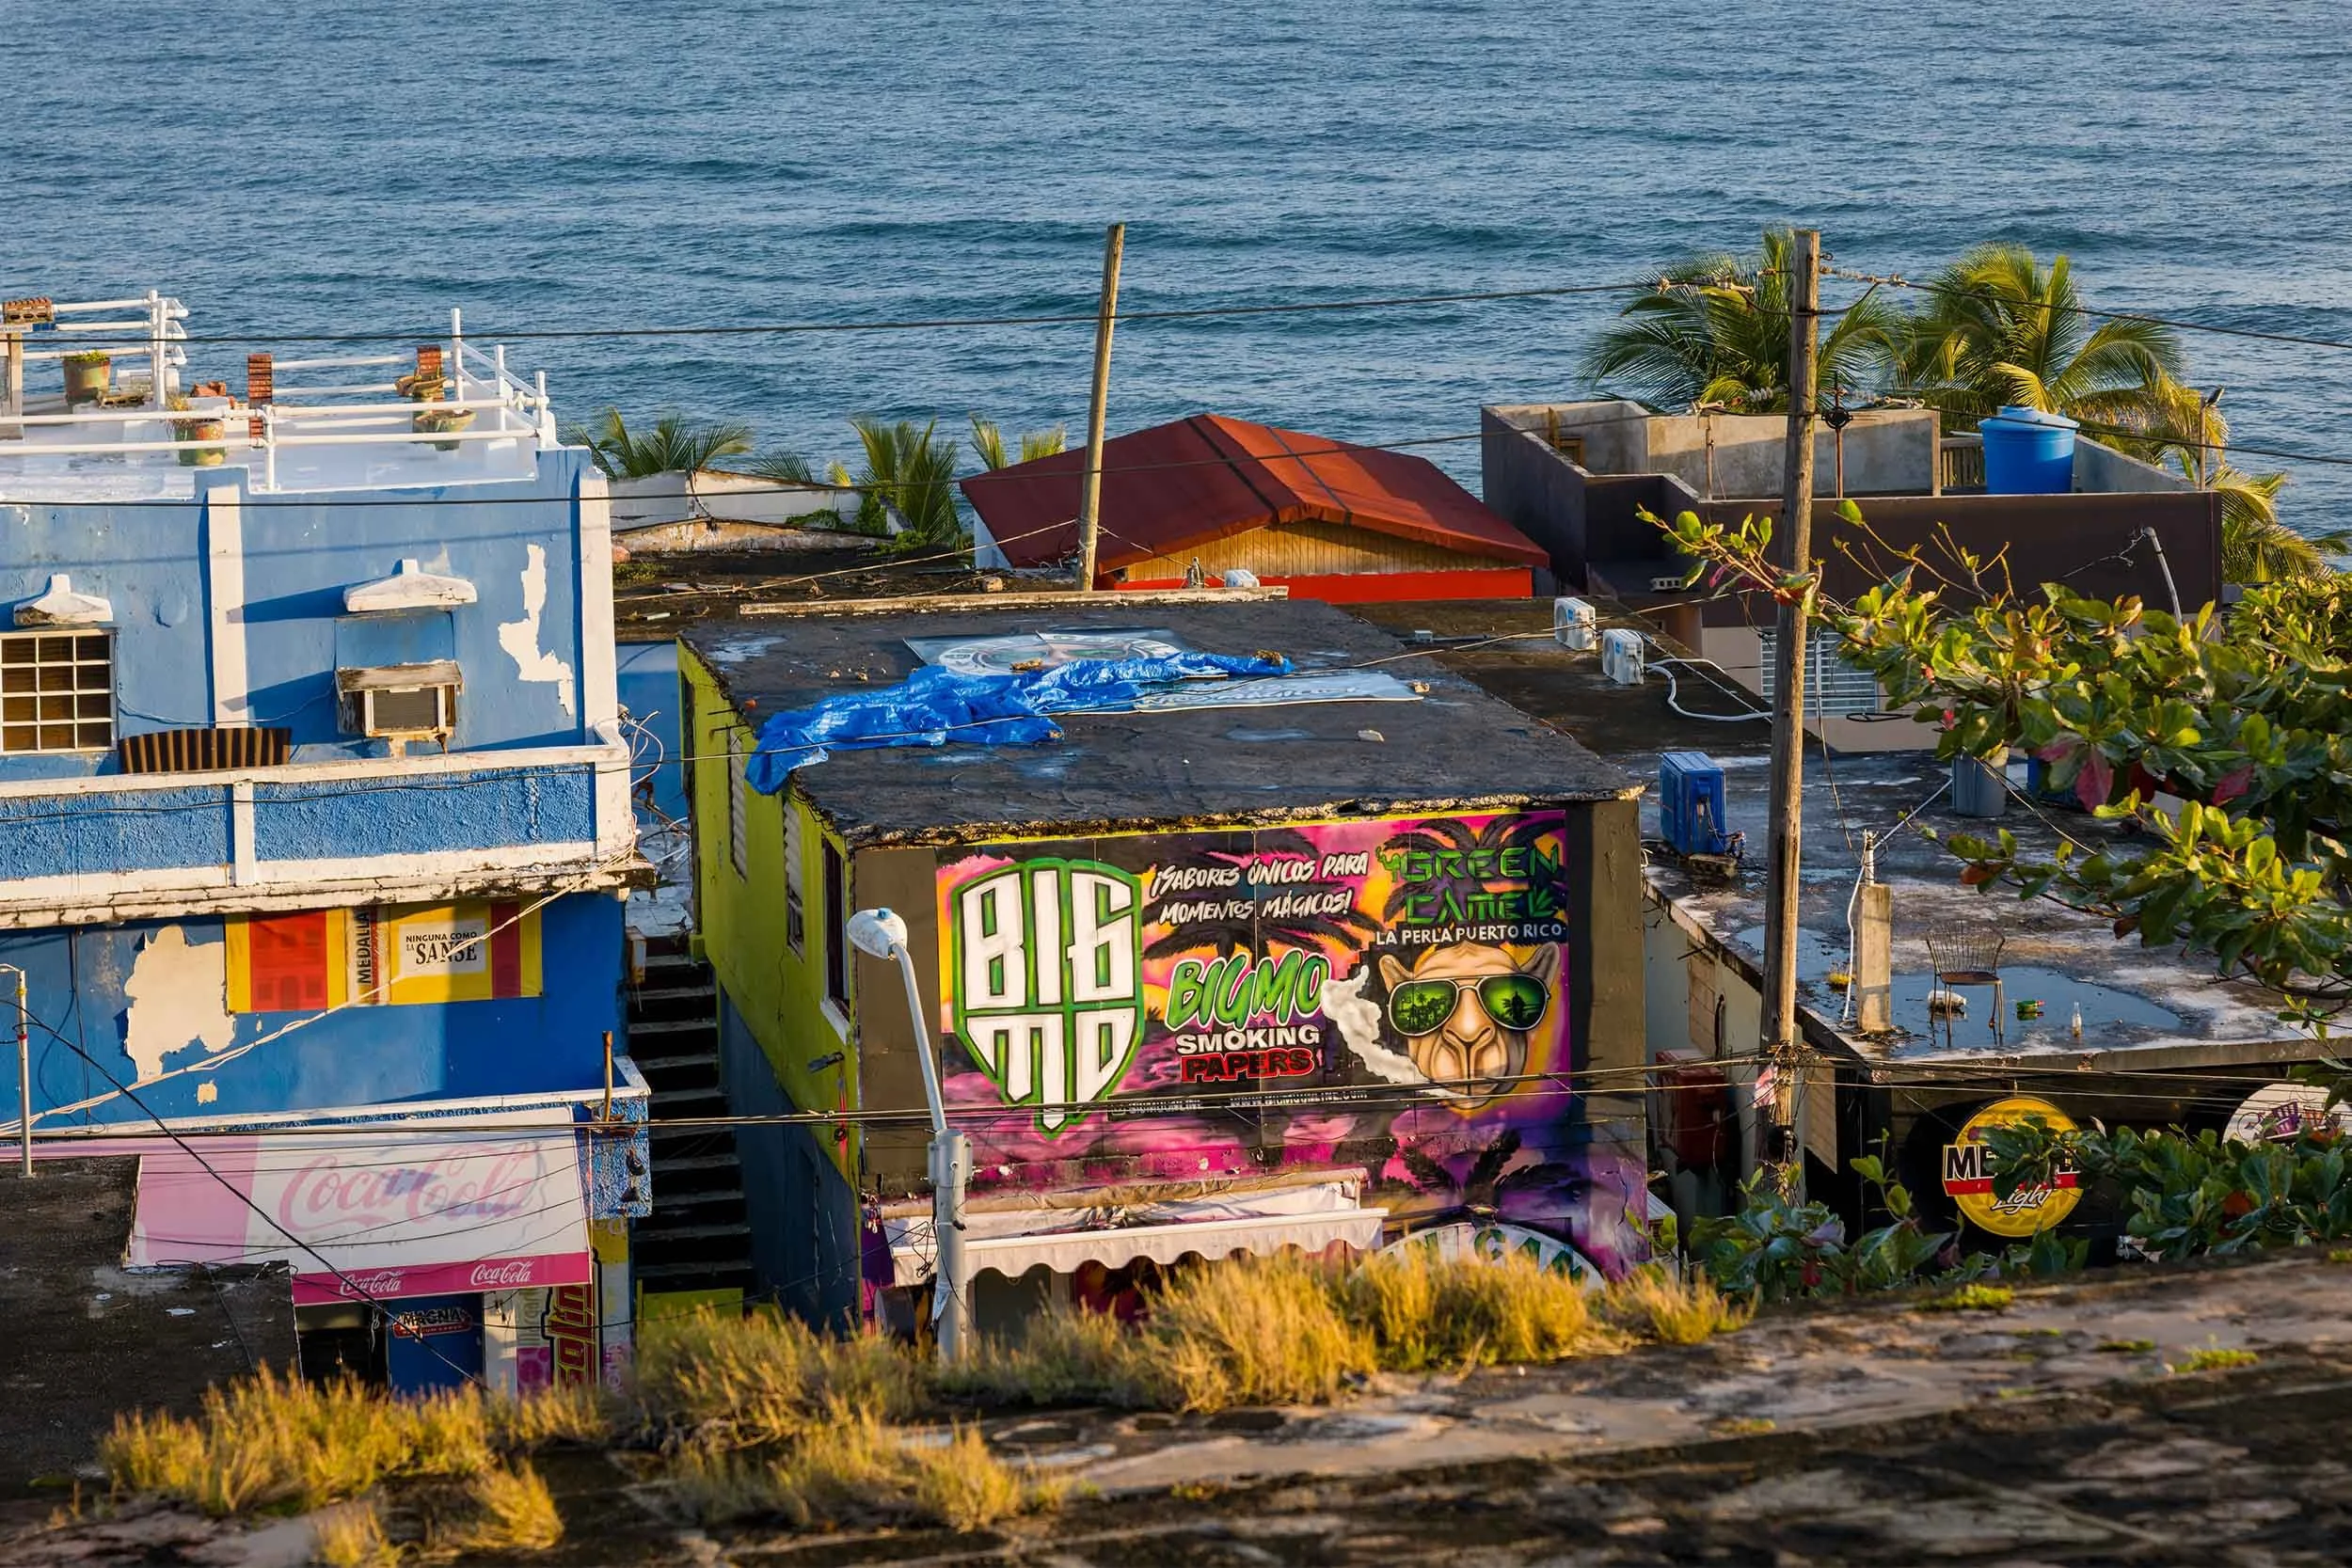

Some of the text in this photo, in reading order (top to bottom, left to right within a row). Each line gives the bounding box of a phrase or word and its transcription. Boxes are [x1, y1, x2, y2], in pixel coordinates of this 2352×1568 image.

[1150, 851, 1370, 896] ¡SABORES ÚNICOS PARA
[1400, 843, 1559, 882] GREEN
[1158, 889, 1354, 926] MOMENTOS MÁGICOS!
[1405, 884, 1558, 925] CAMEL
[354, 911, 372, 984] MEDALLA
[405, 931, 478, 942] NINGUNA COMO
[405, 943, 415, 952] LA
[416, 942, 478, 964] SANSE
[961, 869, 1135, 1010] BIG
[1375, 923, 1562, 945] LA PERLA PUERTO RICO
[1164, 947, 1332, 1032] BIGMO
[1176, 1024, 1320, 1054] SMOKING
[1182, 1048, 1315, 1082] PAPERS
